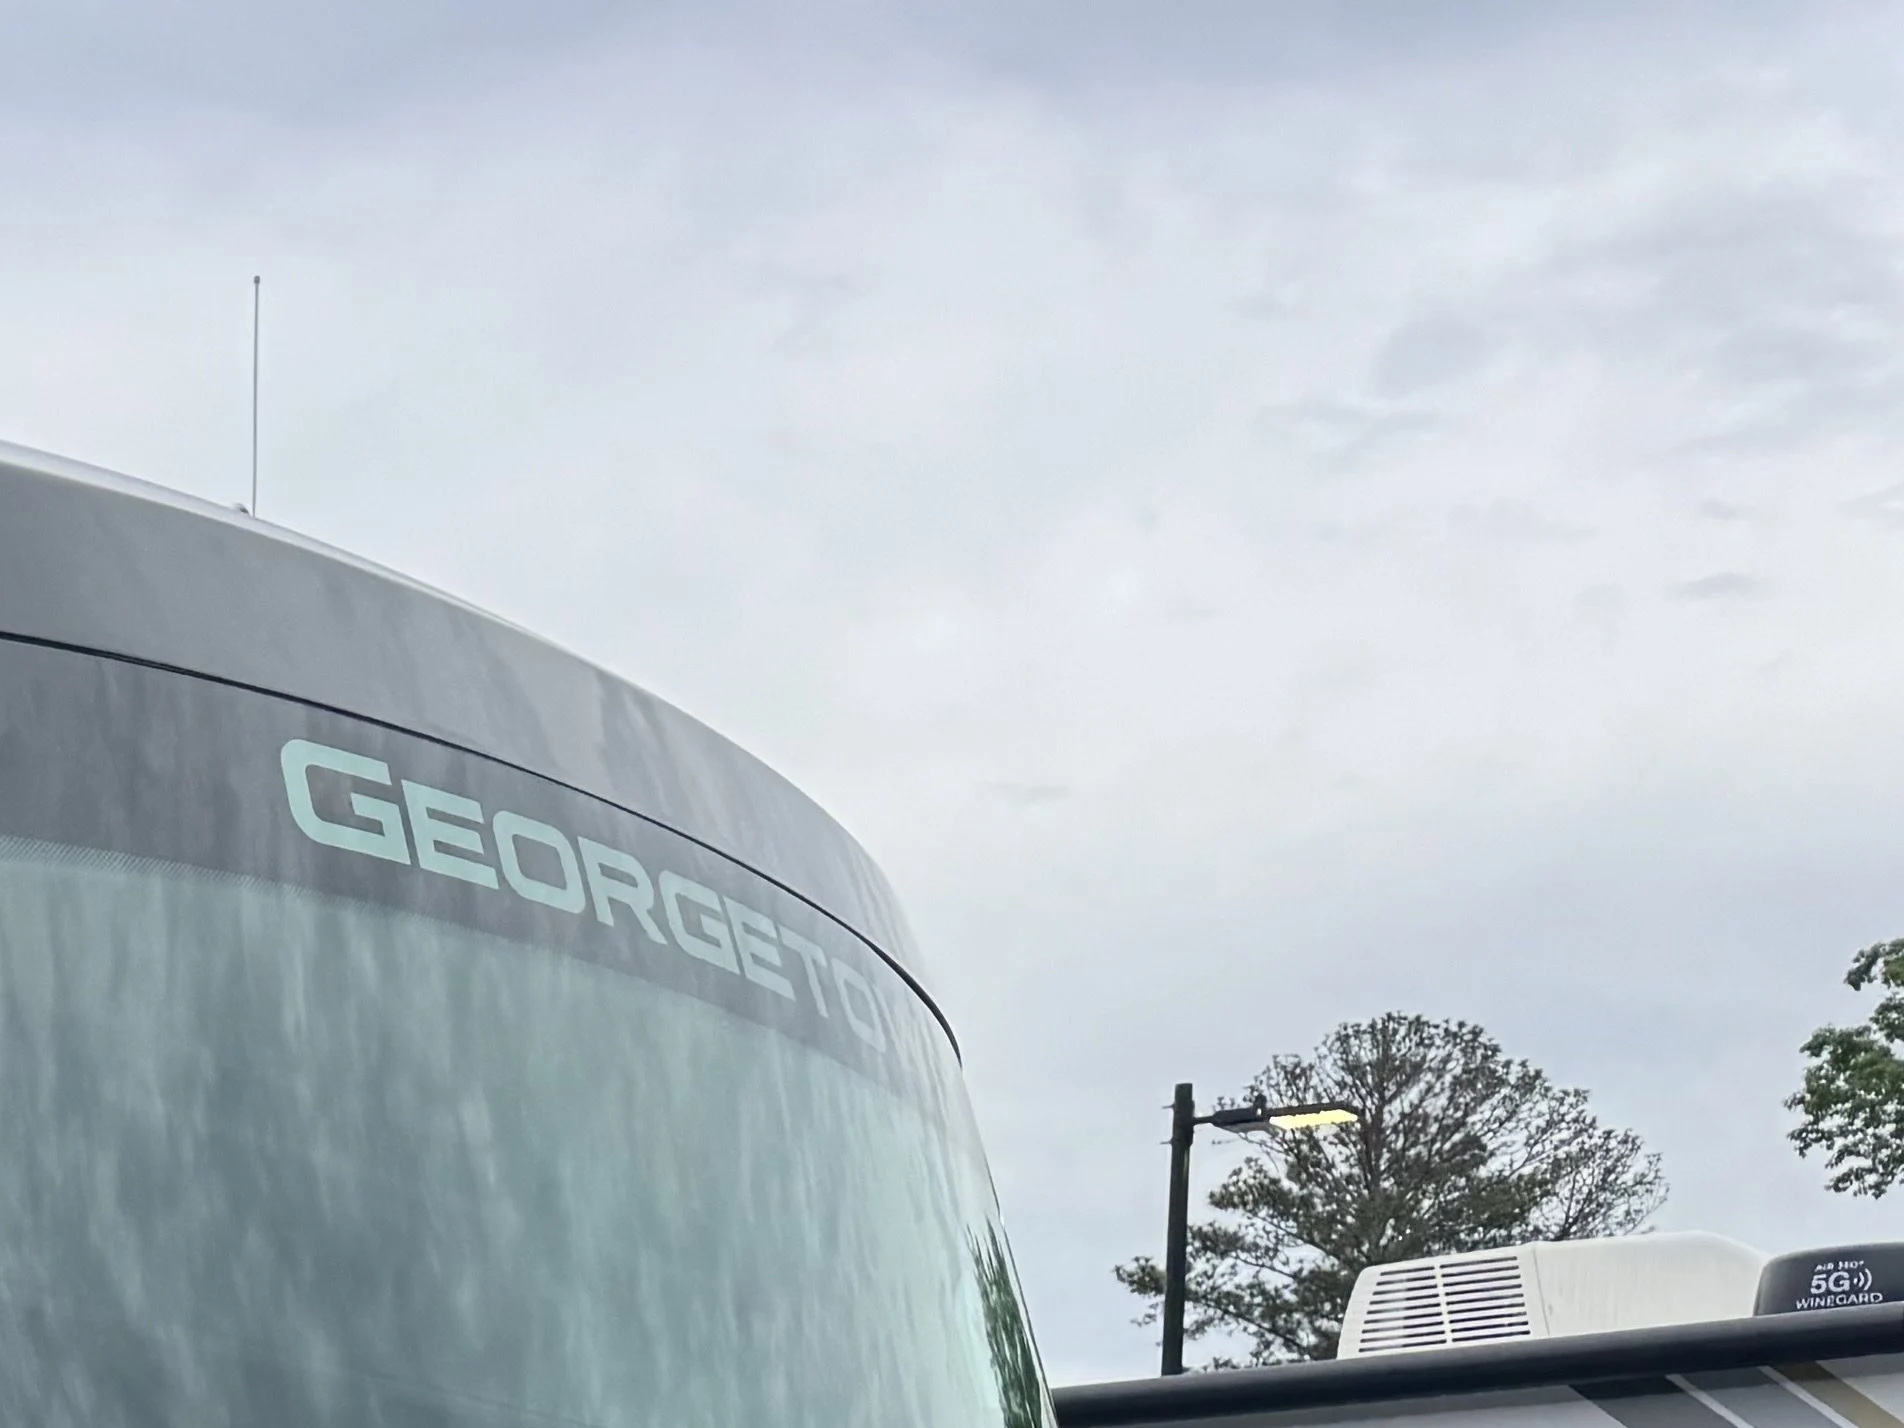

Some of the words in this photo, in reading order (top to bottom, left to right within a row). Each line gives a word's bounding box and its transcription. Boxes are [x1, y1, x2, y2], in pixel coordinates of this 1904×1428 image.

[280, 738, 892, 1055] GEORGETO
[1810, 1271, 1850, 1294] 5G
[1796, 1292, 1883, 1310] WINEGARD
